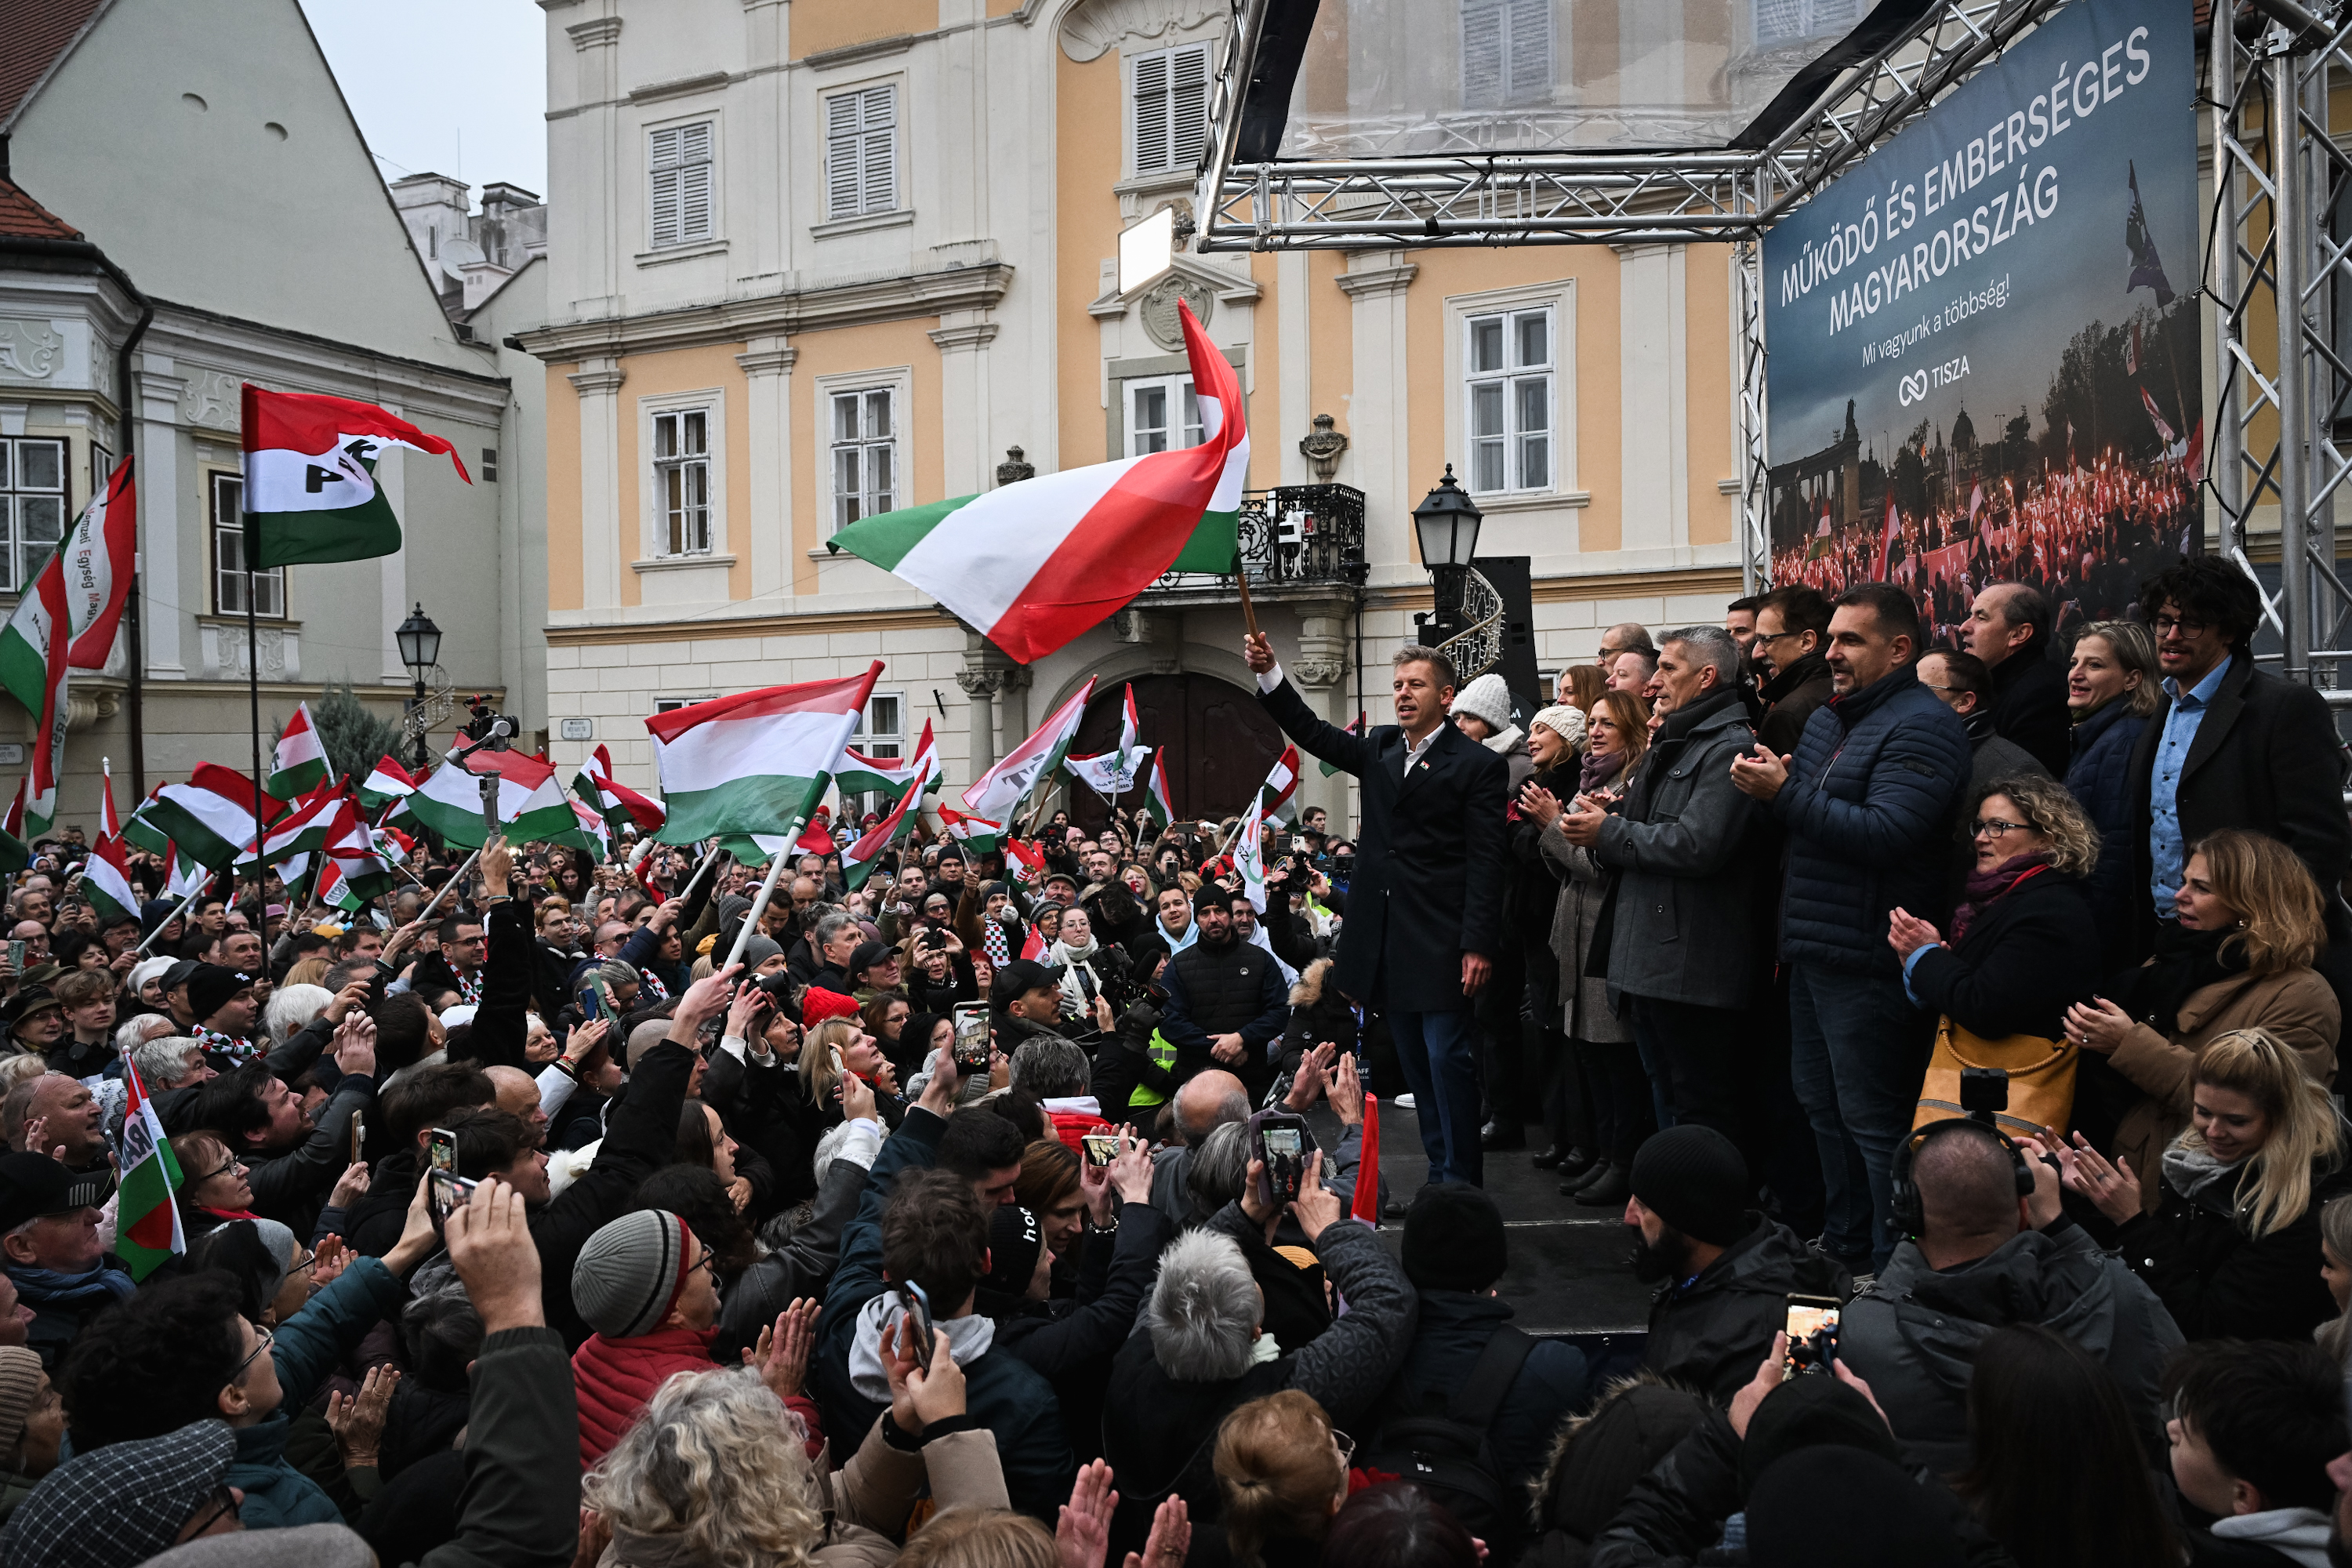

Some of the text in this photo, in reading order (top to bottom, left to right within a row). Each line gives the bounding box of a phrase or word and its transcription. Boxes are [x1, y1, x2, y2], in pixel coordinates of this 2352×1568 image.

[1781, 25, 2151, 308] MŰKÖDŐ ÉS EMBERSÉGES
[1829, 165, 2059, 336] MAGYARORSZÁG
[1862, 273, 2010, 368] Mi vagyunk a többség!
[1931, 354, 1970, 389] TISZA
[77, 550, 94, 589] Egység
